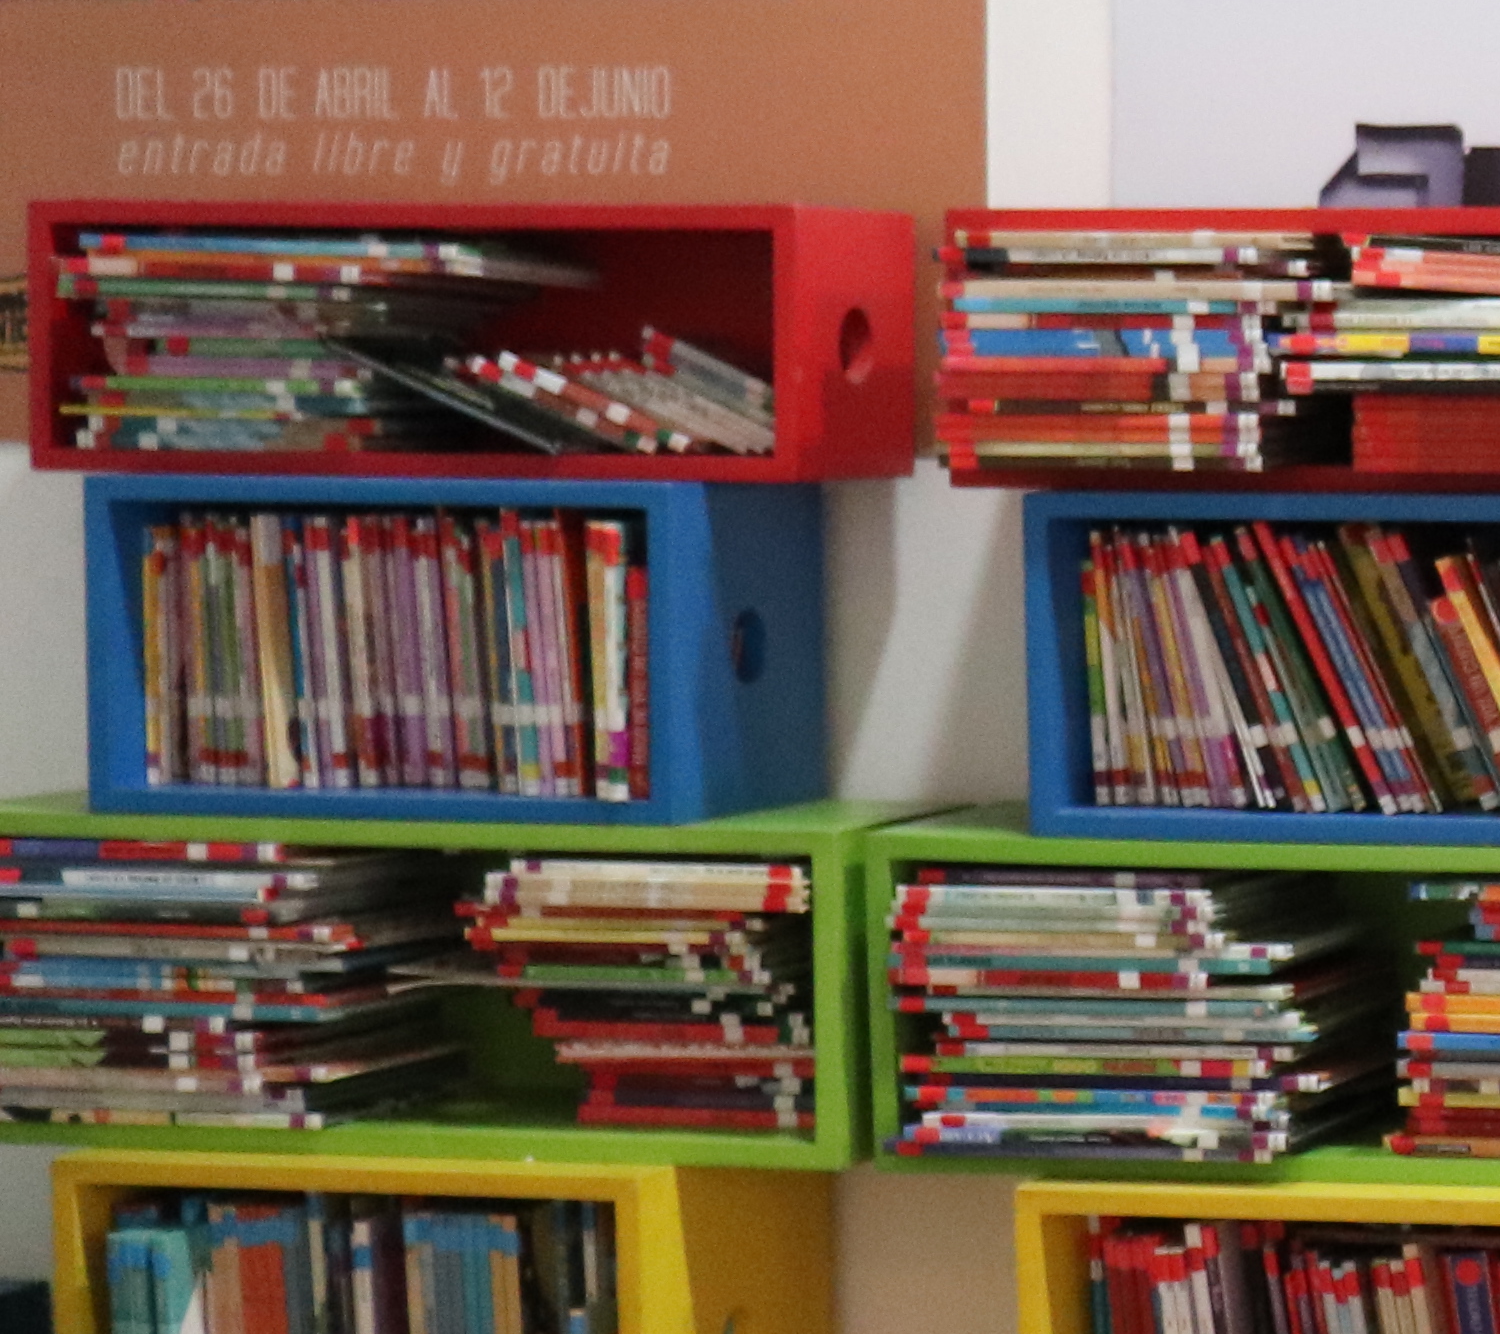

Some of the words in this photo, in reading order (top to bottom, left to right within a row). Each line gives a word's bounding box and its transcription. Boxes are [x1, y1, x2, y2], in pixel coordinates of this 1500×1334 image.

[115, 65, 174, 119] DEL
[191, 67, 234, 119] 26
[257, 67, 298, 118] DE
[313, 66, 395, 119] ABRIL
[423, 66, 459, 120] AL
[481, 66, 513, 118] 12
[117, 132, 288, 175] entrada
[313, 131, 414, 175] libre
[440, 140, 464, 186] y
[489, 130, 671, 186] gratuita
